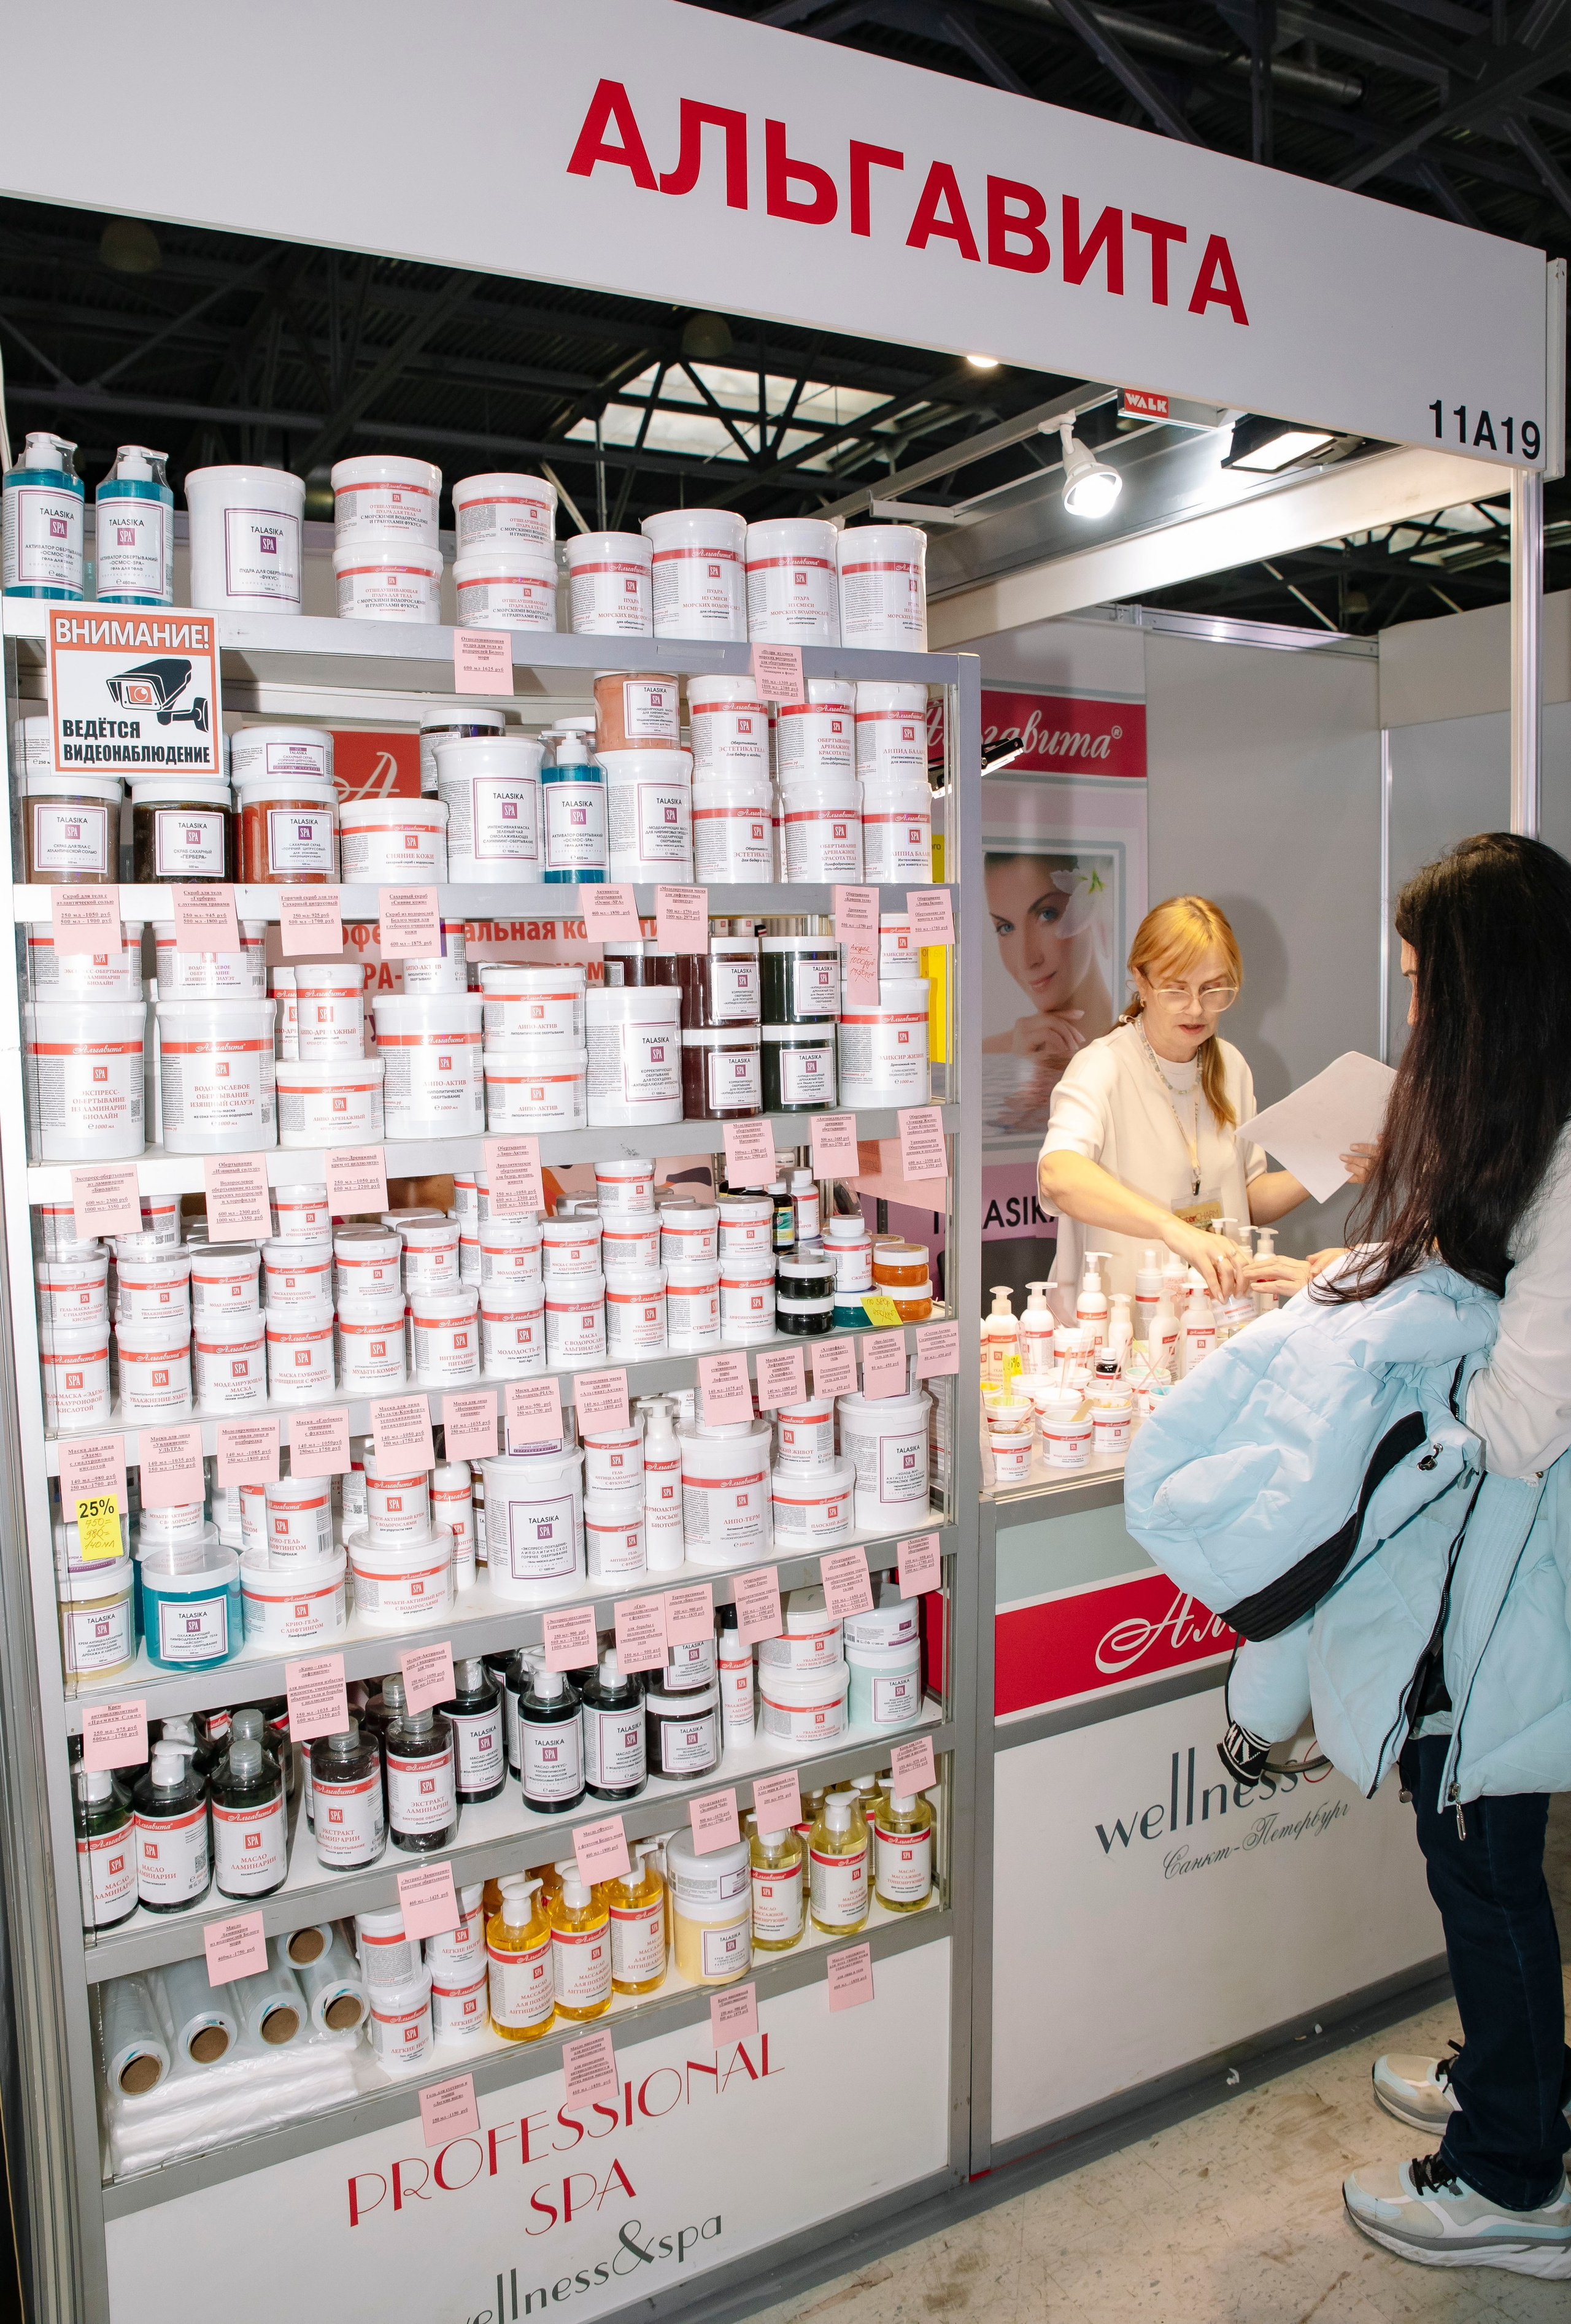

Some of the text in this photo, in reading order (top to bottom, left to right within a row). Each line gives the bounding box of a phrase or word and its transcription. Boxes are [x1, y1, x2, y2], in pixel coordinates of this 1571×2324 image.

[566, 78, 1249, 326] АЛЬГАВИТА
[1125, 391, 1167, 412] WALK
[40, 508, 74, 520] TALASIKA
[52, 521, 65, 535] SPA
[251, 526, 284, 536] TALASIKA
[263, 538, 274, 551] SPA
[56, 619, 209, 649] ВНИМАНИЕ!
[63, 717, 140, 739] ВЕДЁТСЯ
[64, 745, 210, 764] ВИДЕОНАБЛЮДЕНИЕ
[95, 1068, 105, 1080] SPA
[217, 1064, 226, 1075] SPA
[68, 1374, 80, 1386] SPA
[897, 1445, 919, 1453] TALASIKA
[79, 1502, 114, 1518] 25%
[1095, 1741, 1334, 1854] wellness
[1163, 1799, 1349, 1880] Санкт-Петербург
[347, 2032, 786, 2228] PROFESSIONAL
[525, 2158, 637, 2236] SPA
[465, 2214, 722, 2324] ellness&spa
